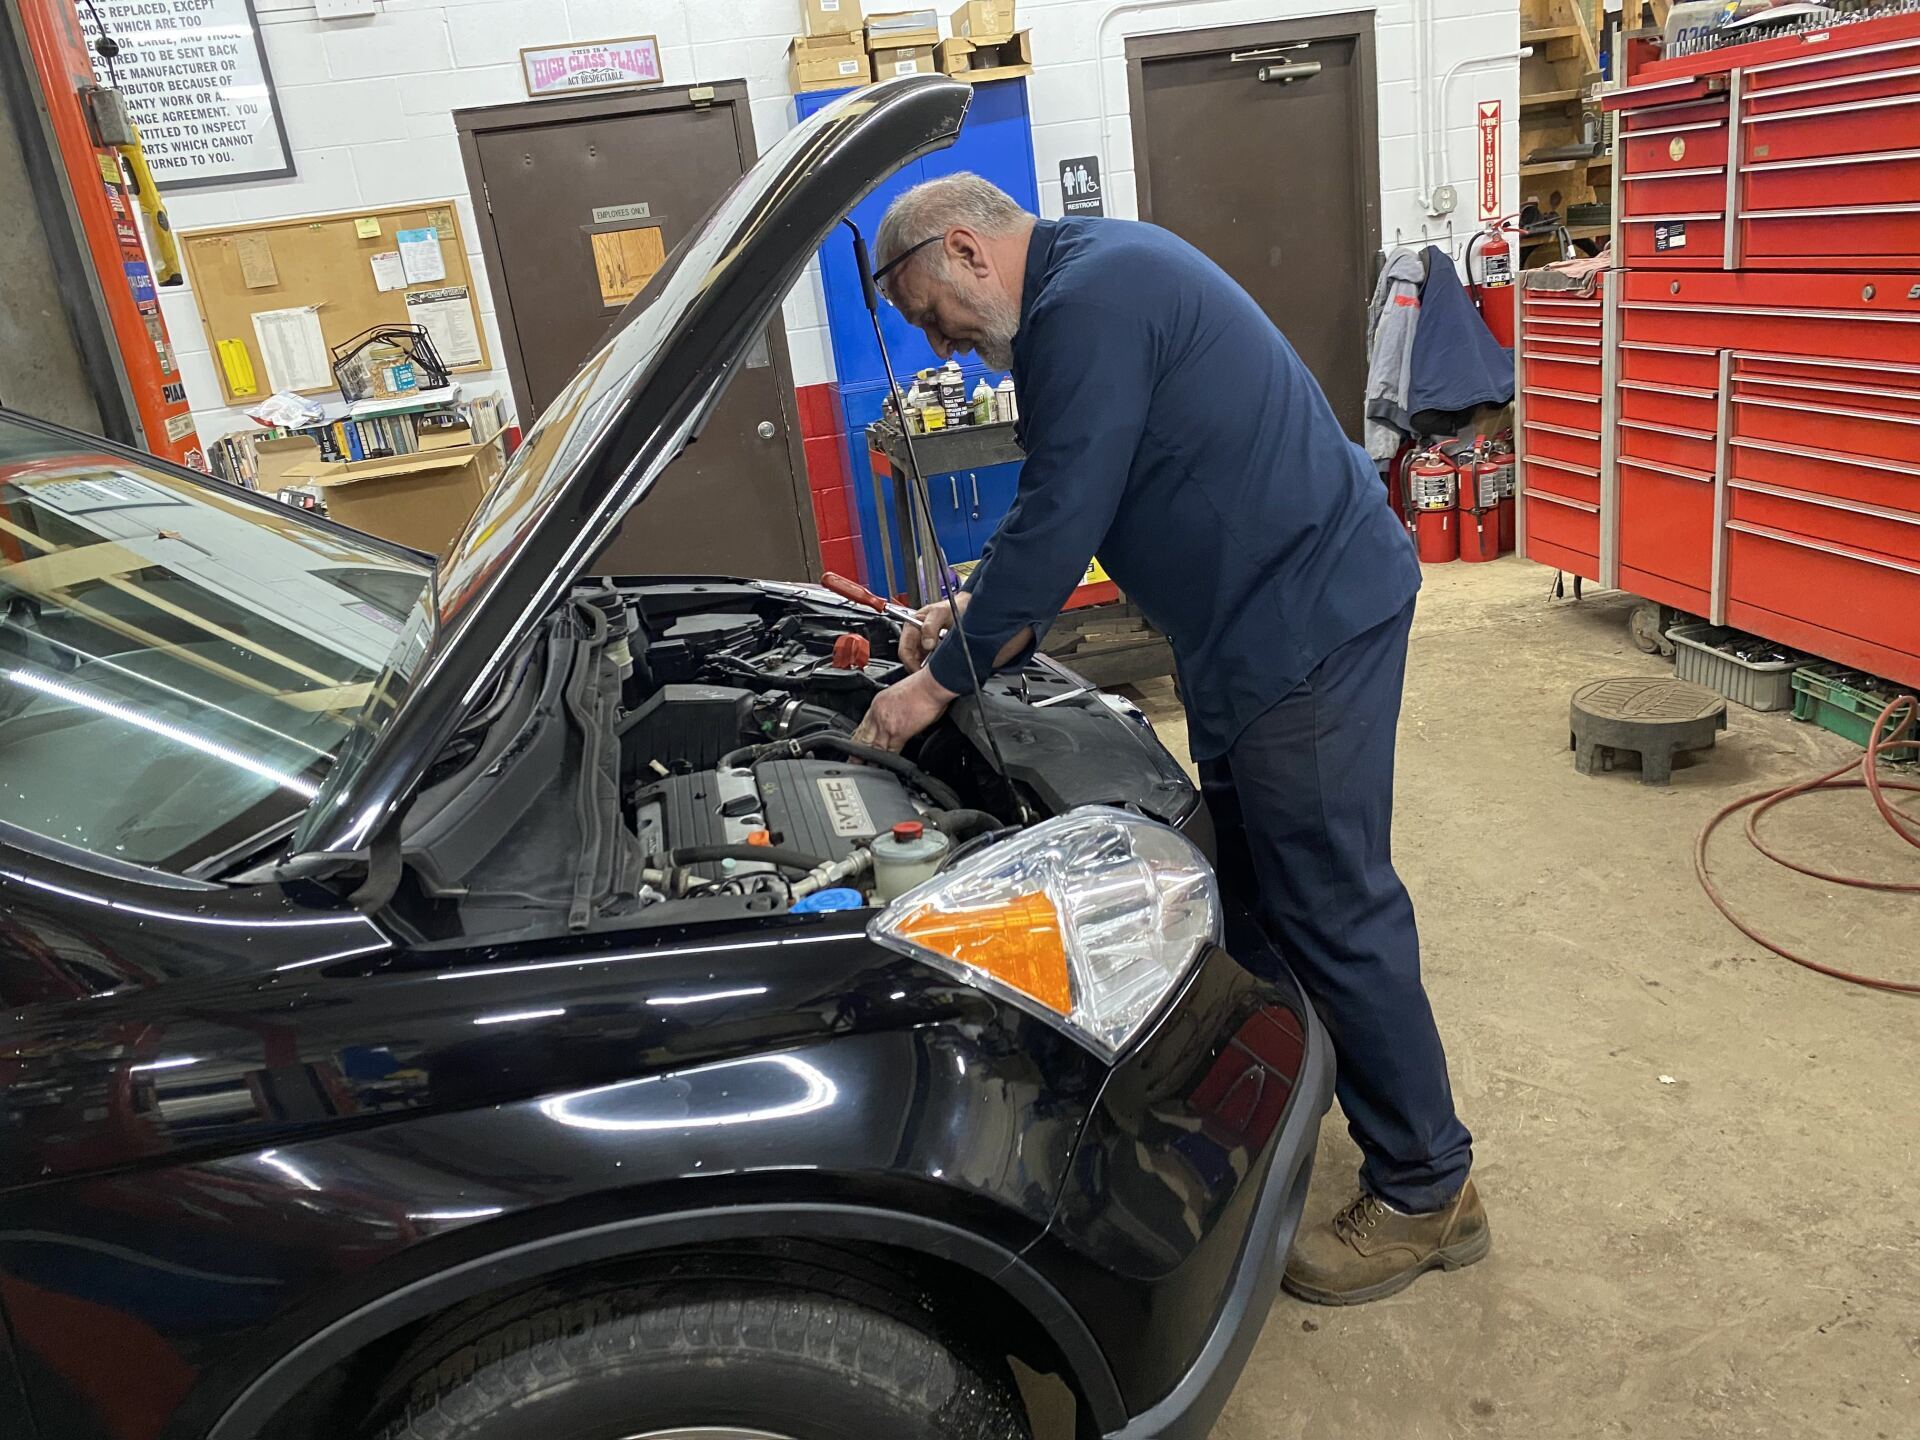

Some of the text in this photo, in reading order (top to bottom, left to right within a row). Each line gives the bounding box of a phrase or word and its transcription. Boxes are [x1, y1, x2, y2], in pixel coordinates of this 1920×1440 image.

[78, 0, 215, 20] ARS REPLACED, EXCEPT
[80, 15, 201, 36] HOSE WHICH ARE TOO
[141, 51, 156, 62] TO
[159, 49, 175, 61] BE
[177, 46, 205, 59] SENT
[209, 44, 239, 57] BACK
[129, 62, 218, 79] MANUFACTURER
[220, 59, 236, 71] OR
[533, 48, 655, 89] HIGH CLASS PLACE
[169, 77, 218, 92] BECAUSE
[219, 75, 233, 86] OF
[568, 71, 624, 86] ACT RESPECTABLE
[159, 95, 195, 107] WORK
[196, 92, 212, 104] OR
[162, 106, 231, 122] AGREEMENT.
[236, 103, 258, 115] YOU
[138, 119, 247, 140] NTITLED TO INSPECT
[1481, 118, 1498, 127] FIRE
[142, 134, 254, 155] ARTS WHICH CANNOT
[146, 151, 235, 170] TURNED TO YOU.
[1486, 126, 1494, 208] EXTINGUISHER
[596, 206, 645, 220] EMPLOYEES ONLY
[1067, 200, 1100, 210] RESTROOM
[162, 383, 186, 404] PIAA
